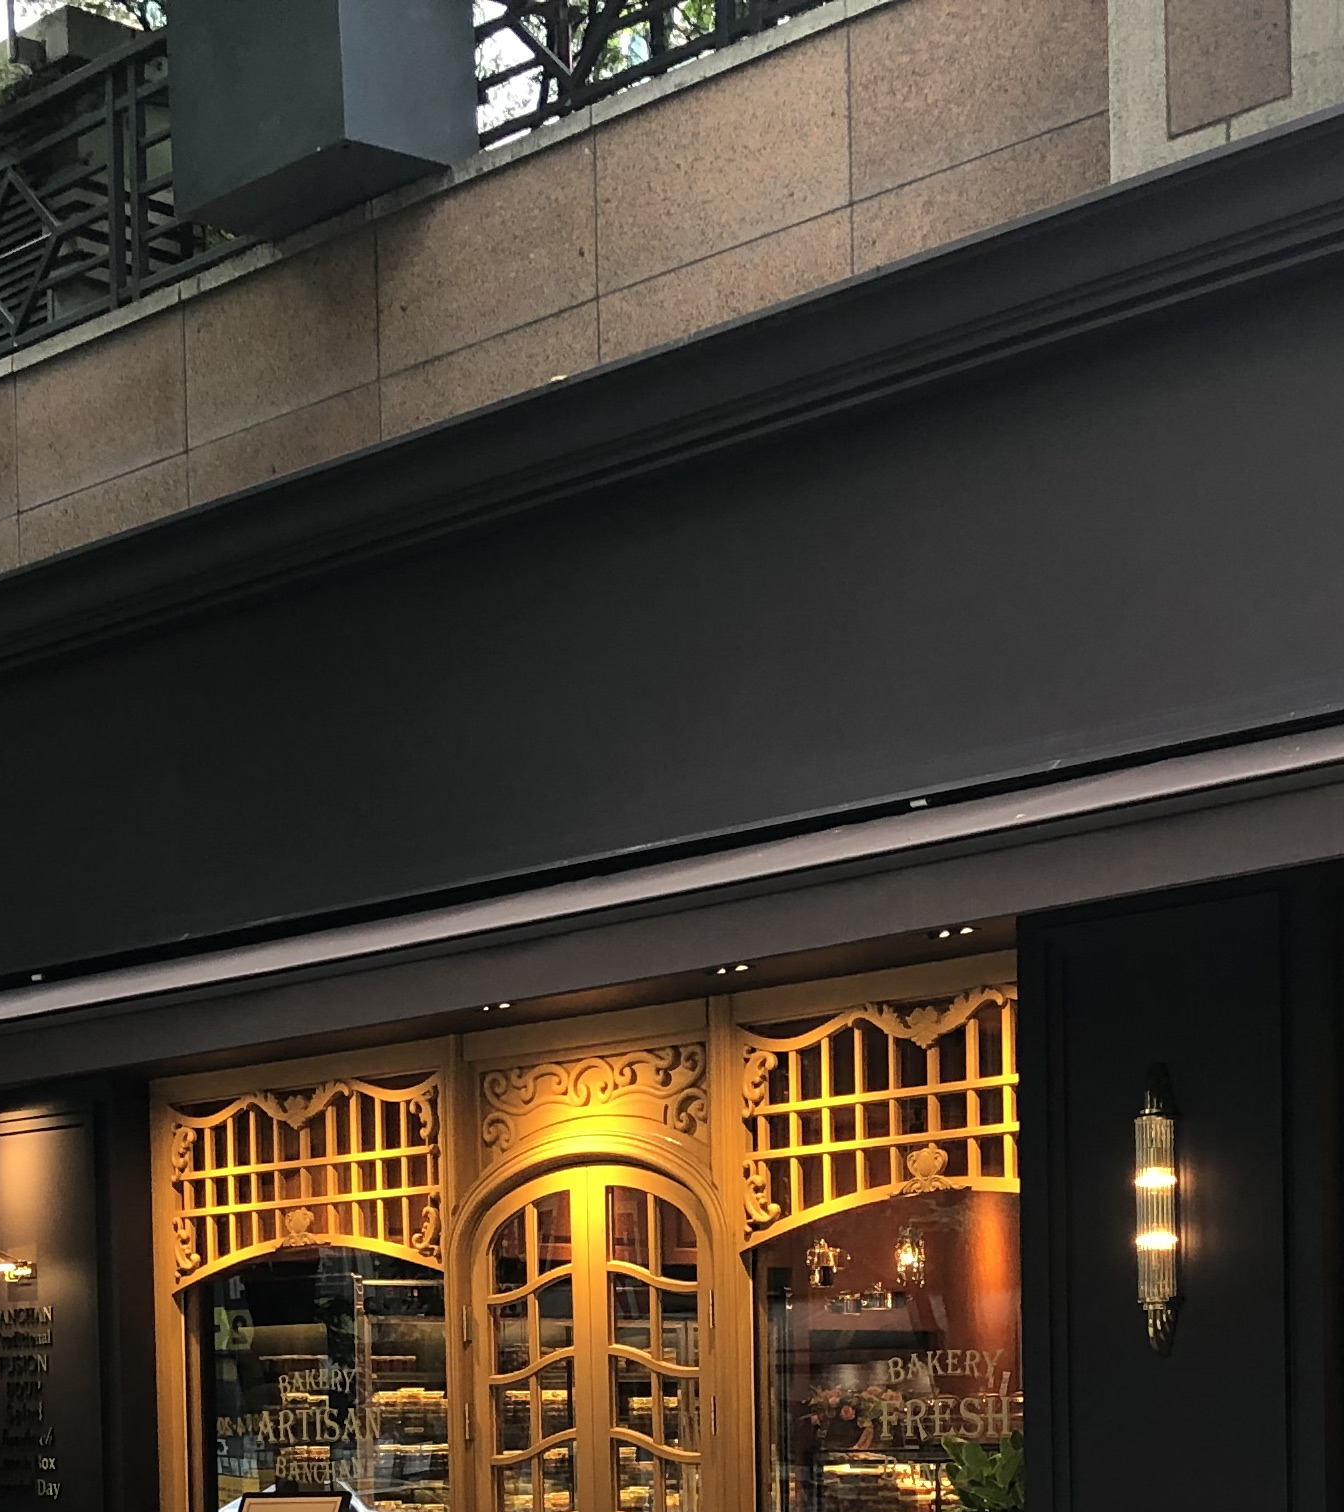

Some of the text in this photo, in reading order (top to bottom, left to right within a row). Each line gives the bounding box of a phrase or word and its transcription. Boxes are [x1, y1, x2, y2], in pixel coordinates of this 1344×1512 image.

[278, 1368, 355, 1397] BAKERY
[887, 1349, 1004, 1389] BAKERY
[256, 1404, 382, 1443] ARTISAN
[879, 1397, 1012, 1441] FRESH
[36, 1478, 61, 1500] Day
